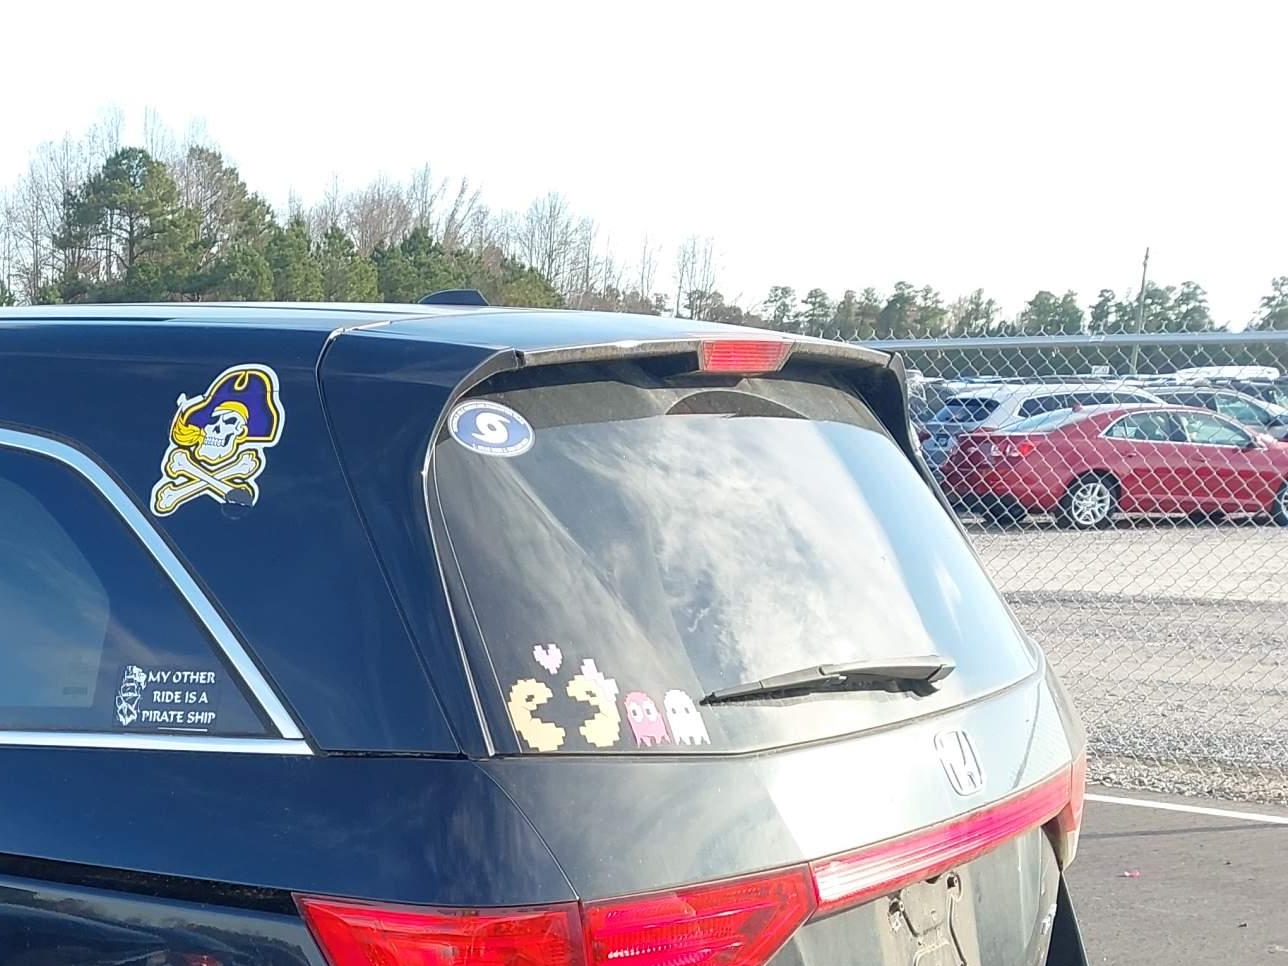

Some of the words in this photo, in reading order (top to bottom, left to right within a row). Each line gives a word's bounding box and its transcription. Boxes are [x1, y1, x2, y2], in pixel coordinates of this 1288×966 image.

[147, 671, 171, 683] MY
[172, 671, 216, 684] OTHER
[152, 691, 182, 703] RIDE
[185, 691, 197, 704] IS
[198, 692, 209, 703] A
[141, 710, 184, 723] PIRATE
[187, 712, 216, 724] SHIP
